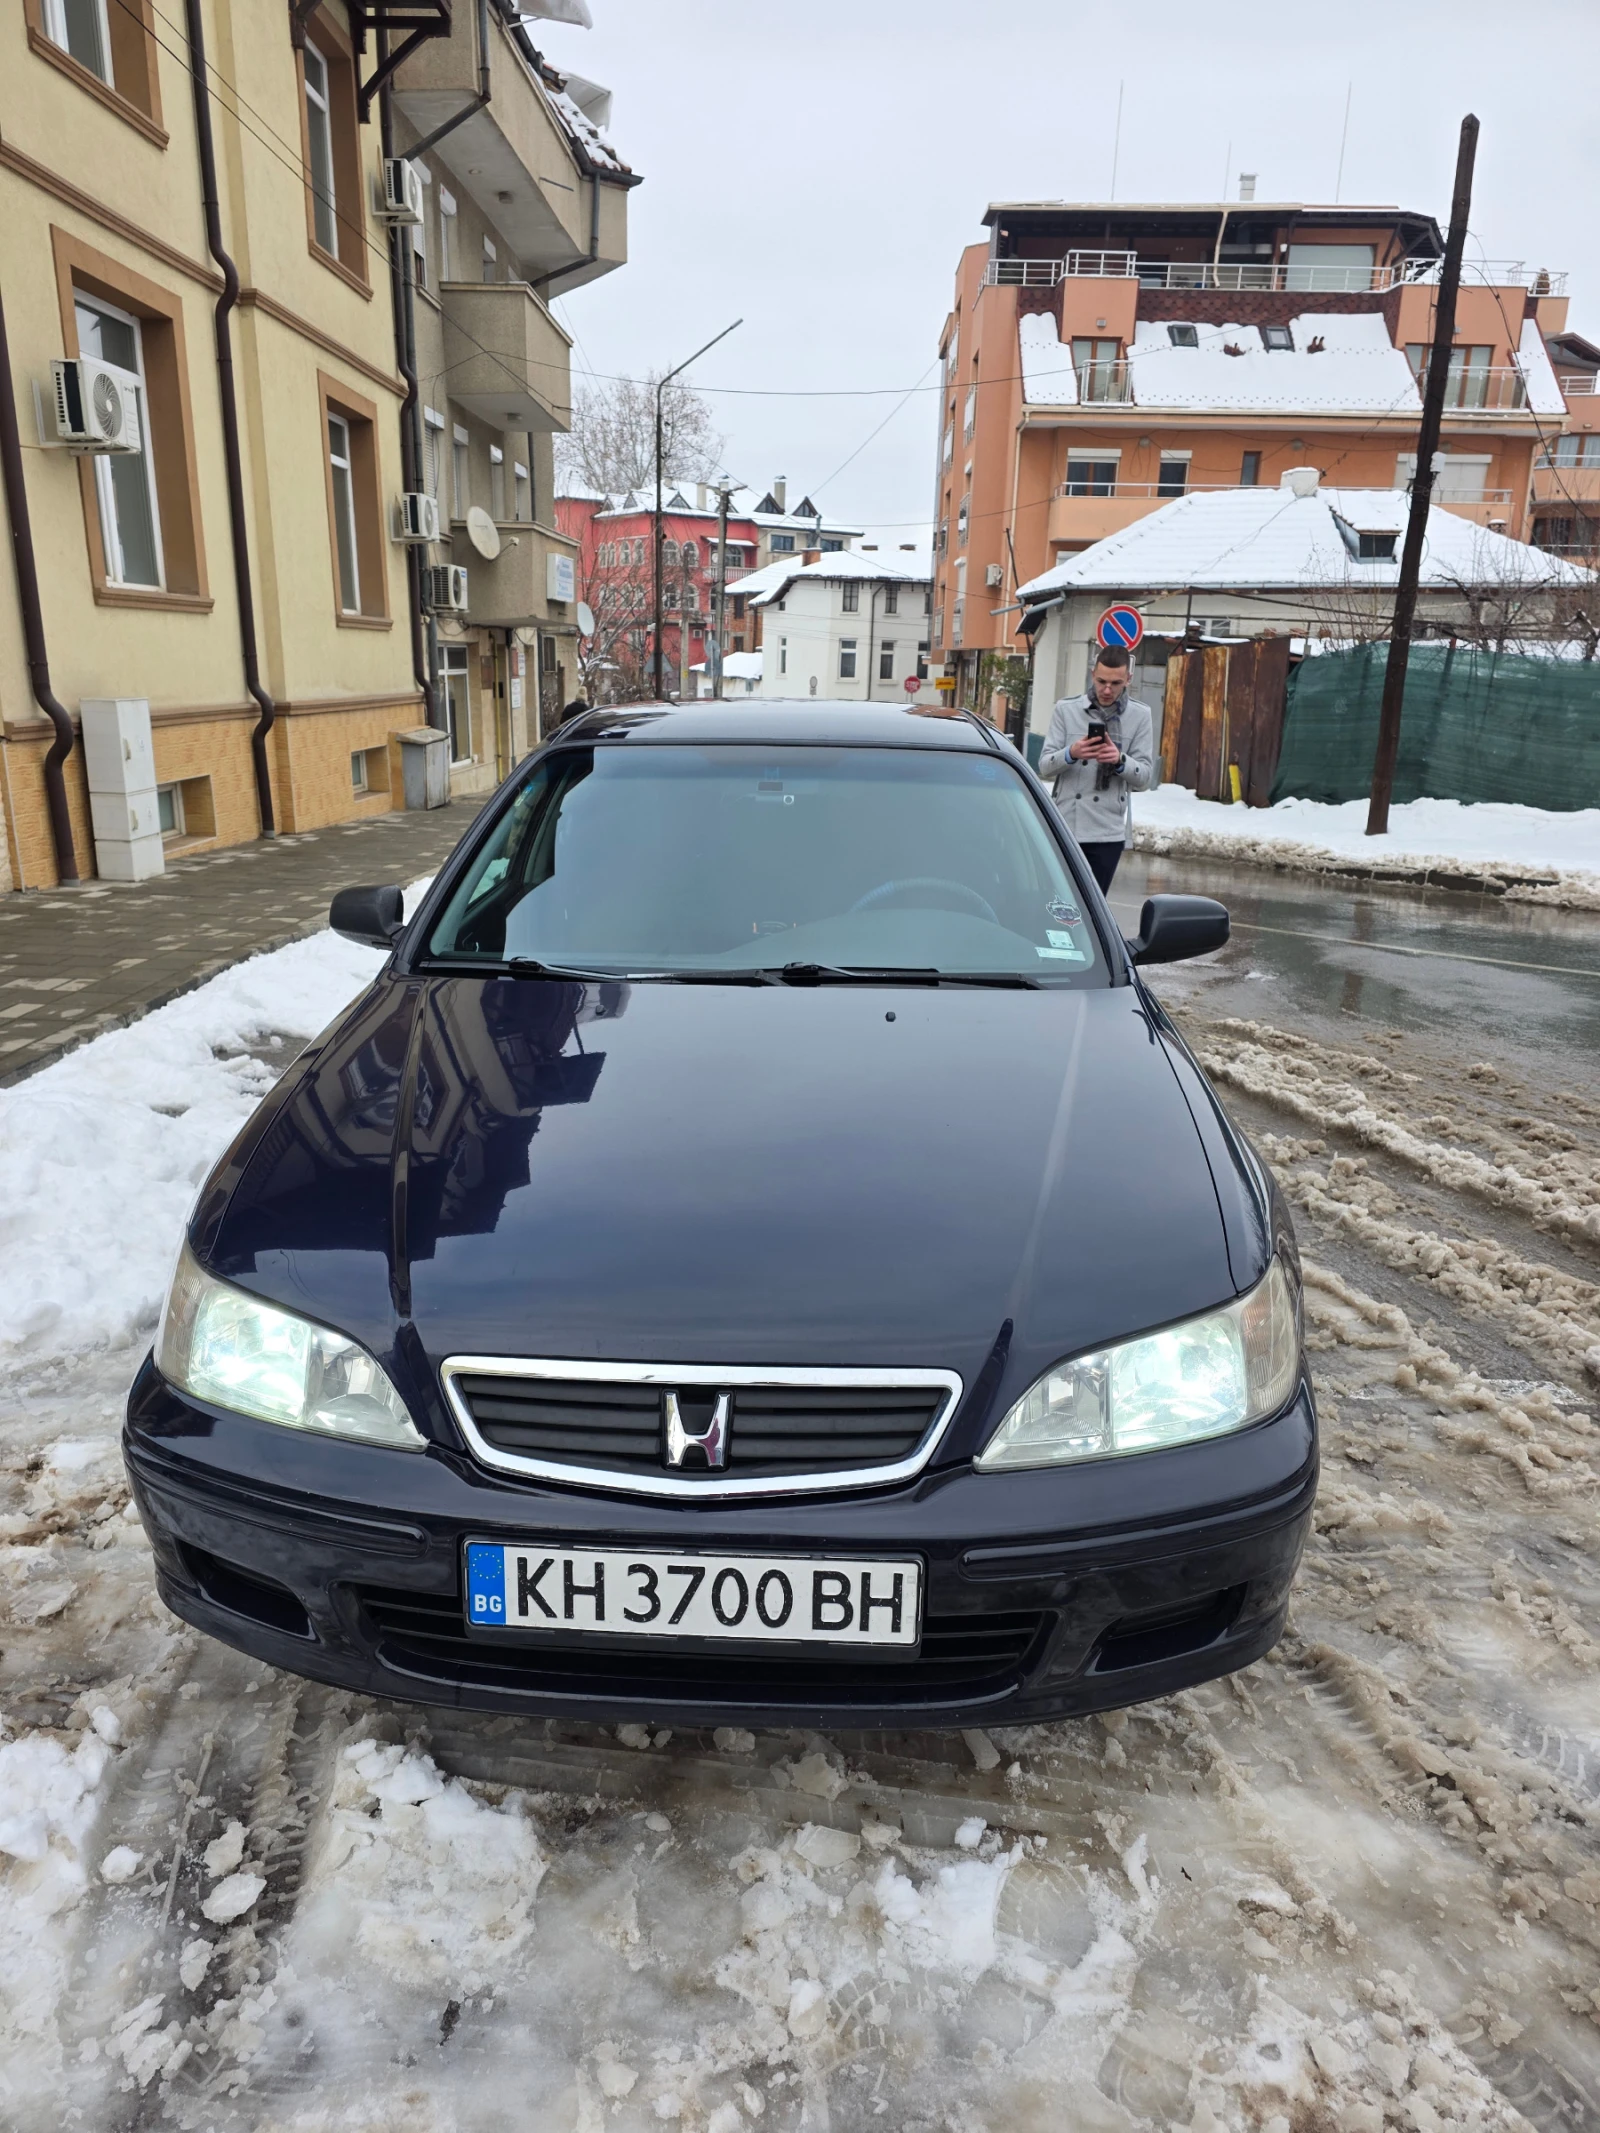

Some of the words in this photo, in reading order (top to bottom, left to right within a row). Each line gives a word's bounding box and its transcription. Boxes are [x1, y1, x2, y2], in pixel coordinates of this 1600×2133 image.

[474, 1594, 502, 1613] BG
[517, 1556, 605, 1621] KH
[623, 1563, 794, 1628] 3700
[812, 1569, 904, 1633] BH
